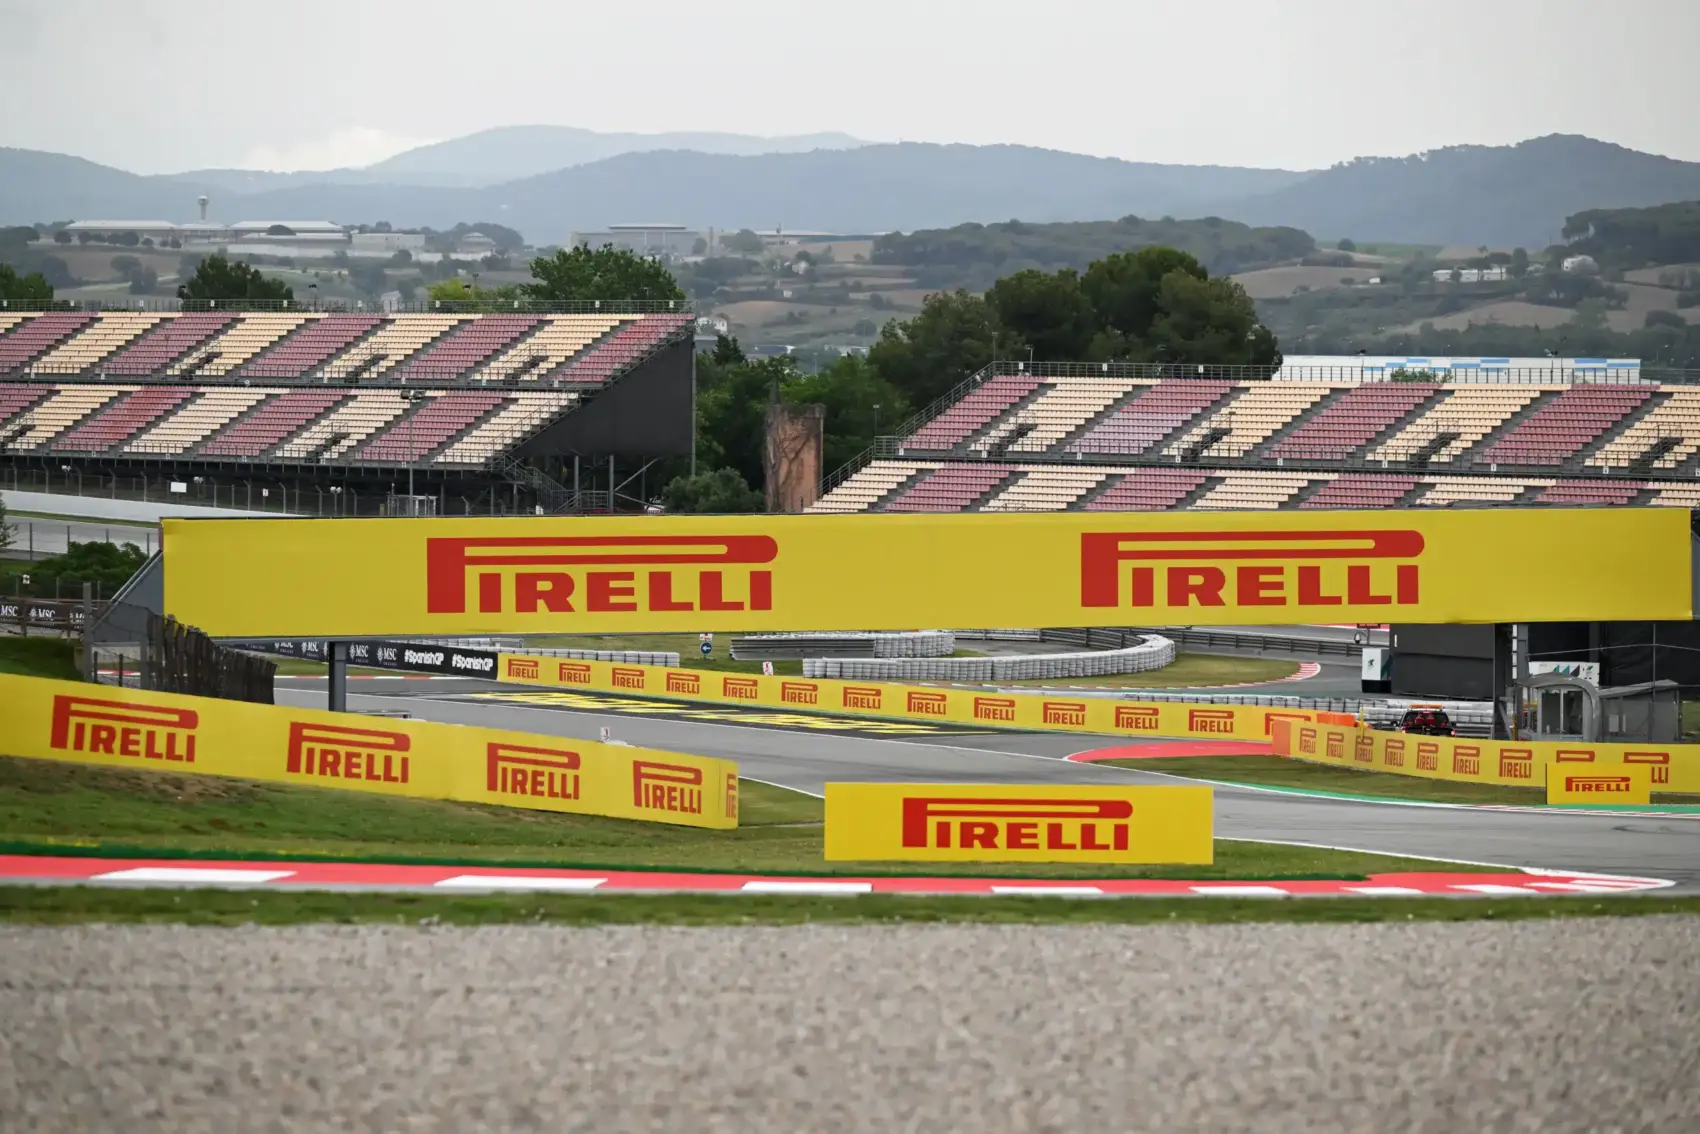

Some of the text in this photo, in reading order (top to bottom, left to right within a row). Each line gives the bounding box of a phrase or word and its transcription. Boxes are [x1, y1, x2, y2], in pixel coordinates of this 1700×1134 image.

[427, 534, 778, 613] PIRELLI
[1081, 529, 1424, 607] PIRELLI
[355, 644, 369, 658] MSC
[383, 647, 398, 660] MSC
[404, 649, 444, 666] #SpanishGP
[451, 653, 493, 672] #SpanishGP
[507, 658, 539, 679] PIRELLI
[558, 663, 591, 683] PIRELLI
[612, 667, 645, 689] PIRELLI
[666, 672, 700, 694] PIRELLI
[722, 677, 758, 699] PIRELLI
[781, 681, 818, 705] PIRELLI
[843, 686, 882, 709] PIRELLI
[907, 691, 947, 715] PIRELLI
[974, 696, 1016, 721] PIRELLI
[1042, 701, 1086, 725] PIRELLI
[1114, 706, 1160, 730] PIRELLI
[1188, 710, 1234, 734] PIRELLI
[50, 695, 200, 763] PIRELLI
[287, 722, 411, 784] PIRELLI
[1416, 742, 1438, 771] PIRELLI
[1453, 745, 1480, 775] PIRELLI
[1499, 748, 1533, 778] PIRELLI
[487, 742, 581, 800] PIRELLI
[632, 760, 703, 815] PIRELLI
[1565, 776, 1631, 792] PIRELLI
[902, 797, 1133, 850] PIRELLI
